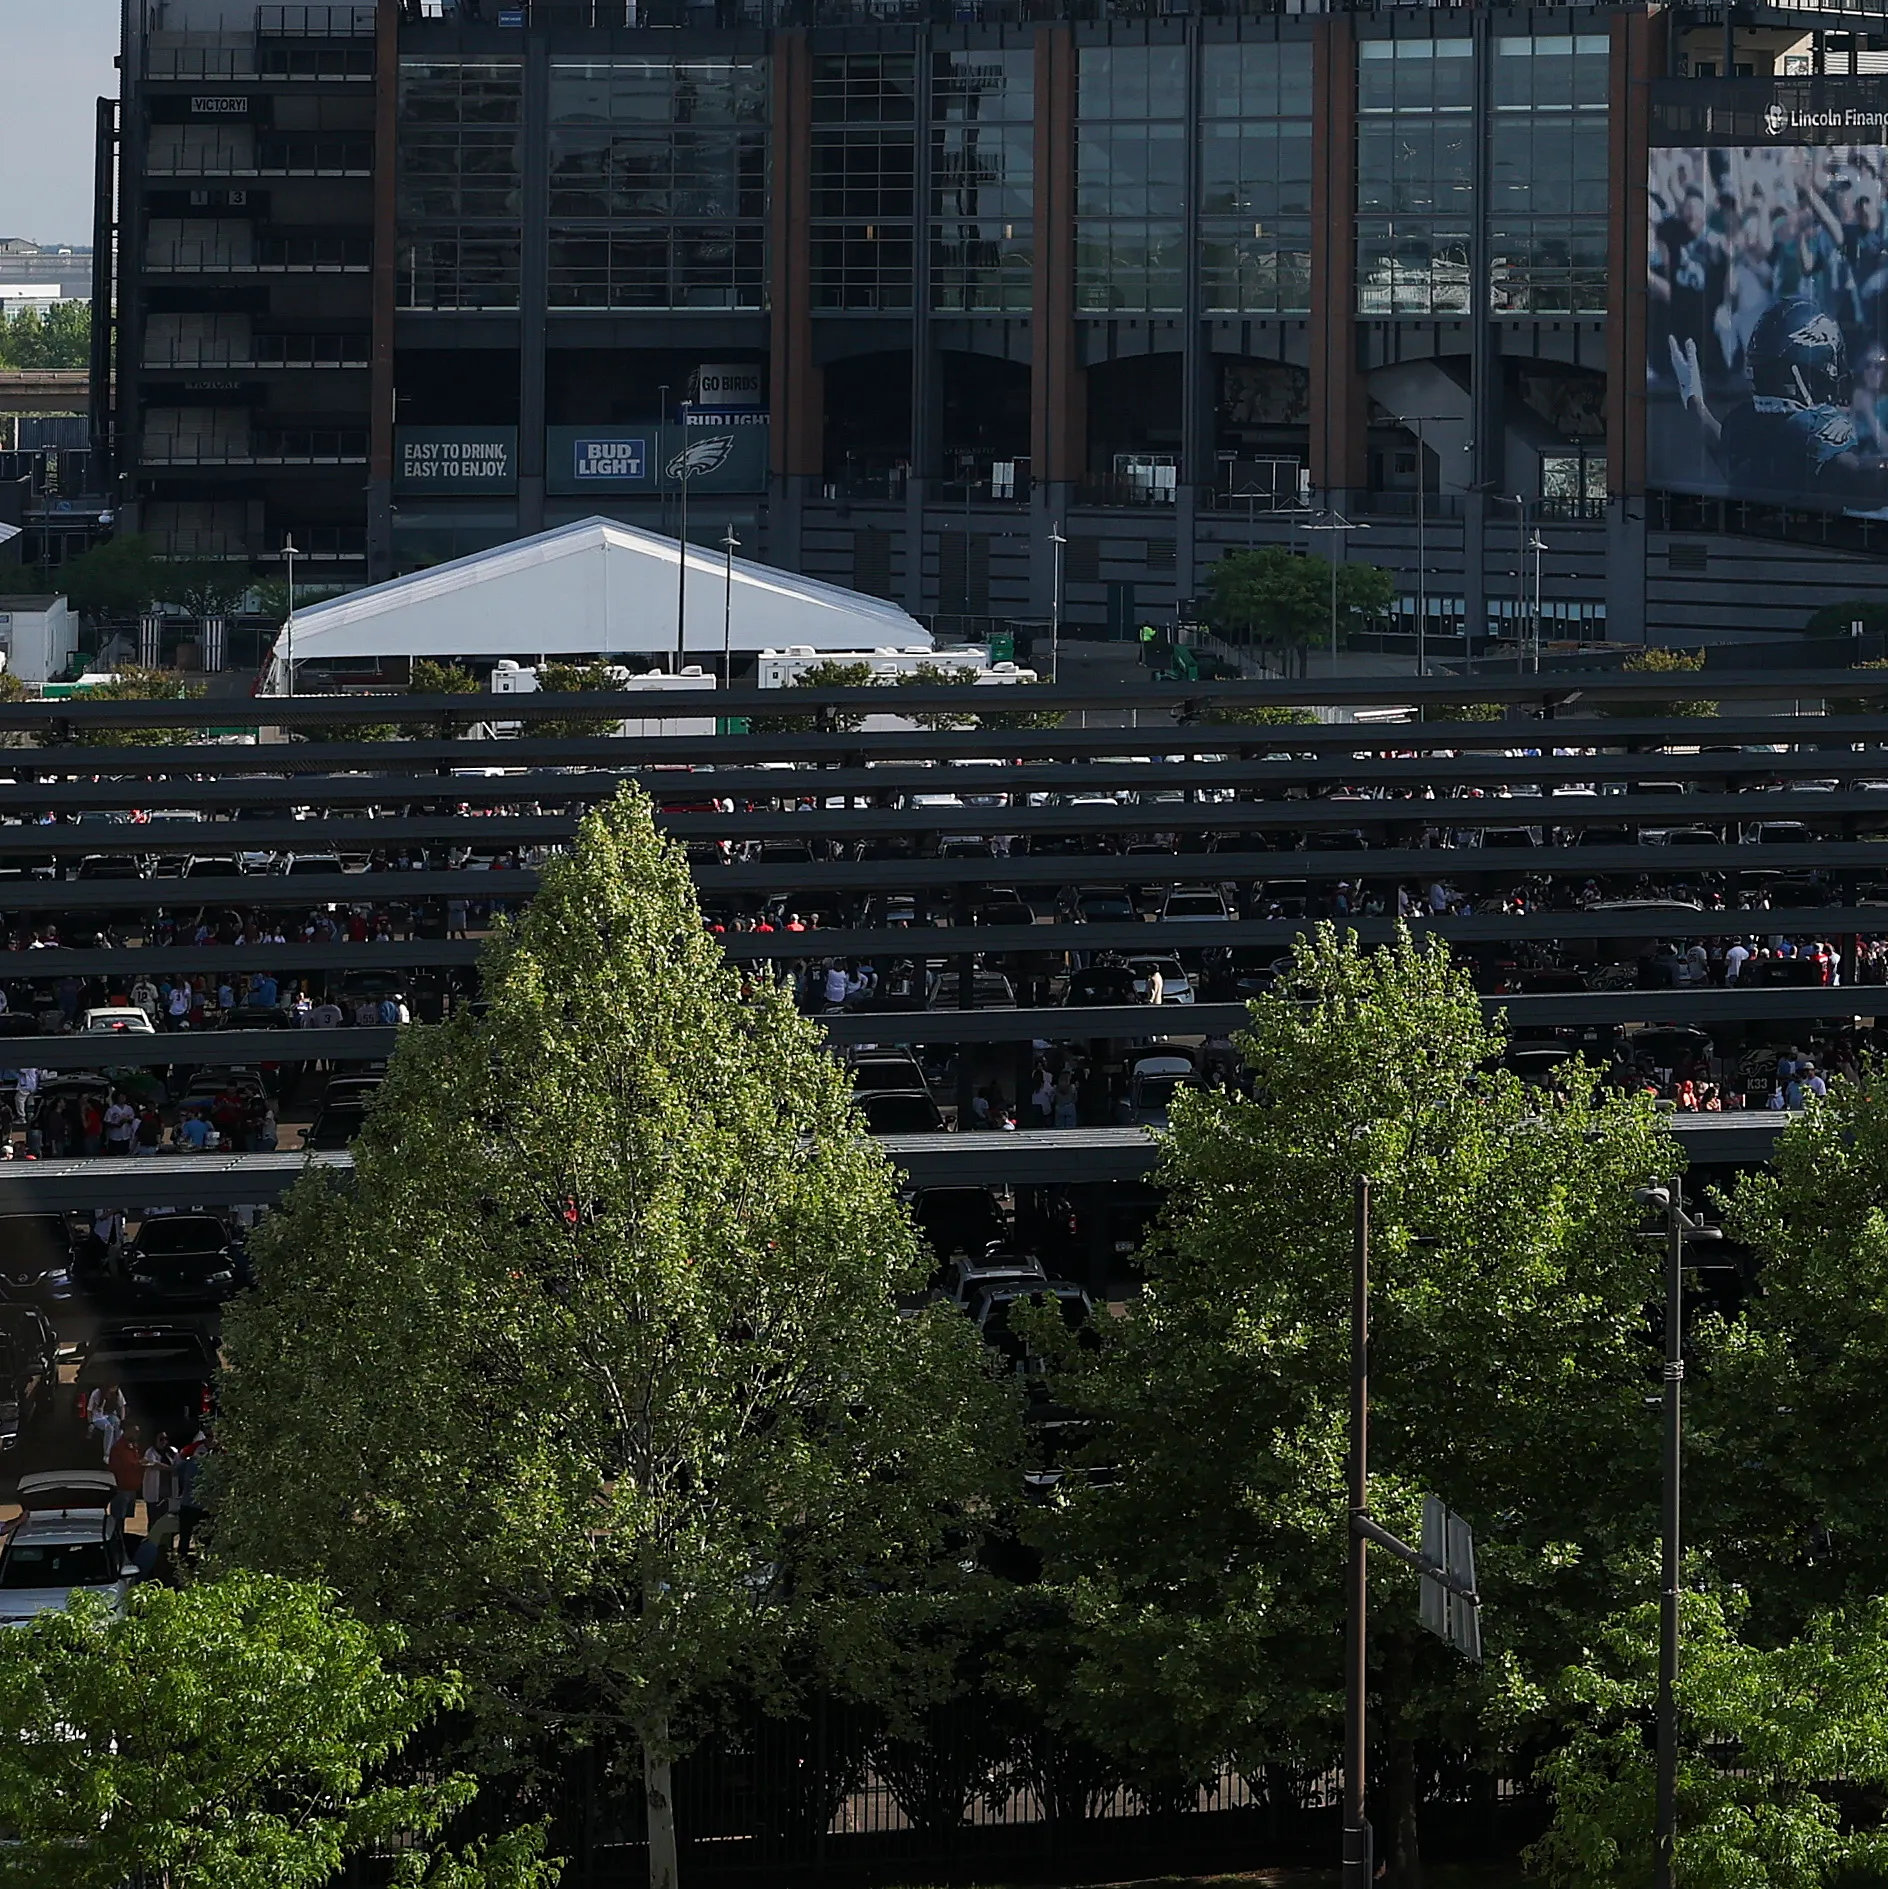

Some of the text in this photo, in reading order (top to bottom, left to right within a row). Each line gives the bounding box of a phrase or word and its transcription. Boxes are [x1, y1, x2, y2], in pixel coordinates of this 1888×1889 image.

[195, 98, 248, 112] VICTORY!
[1791, 110, 1842, 128] Lincoln
[702, 375, 759, 392] GO BIRDS
[405, 444, 507, 461] EASY TO DRINK,
[588, 443, 632, 460] BUD
[405, 461, 507, 477] EASY TO ENJOY.
[579, 459, 641, 475] LIGHT
[1747, 1077, 1768, 1090] K33
